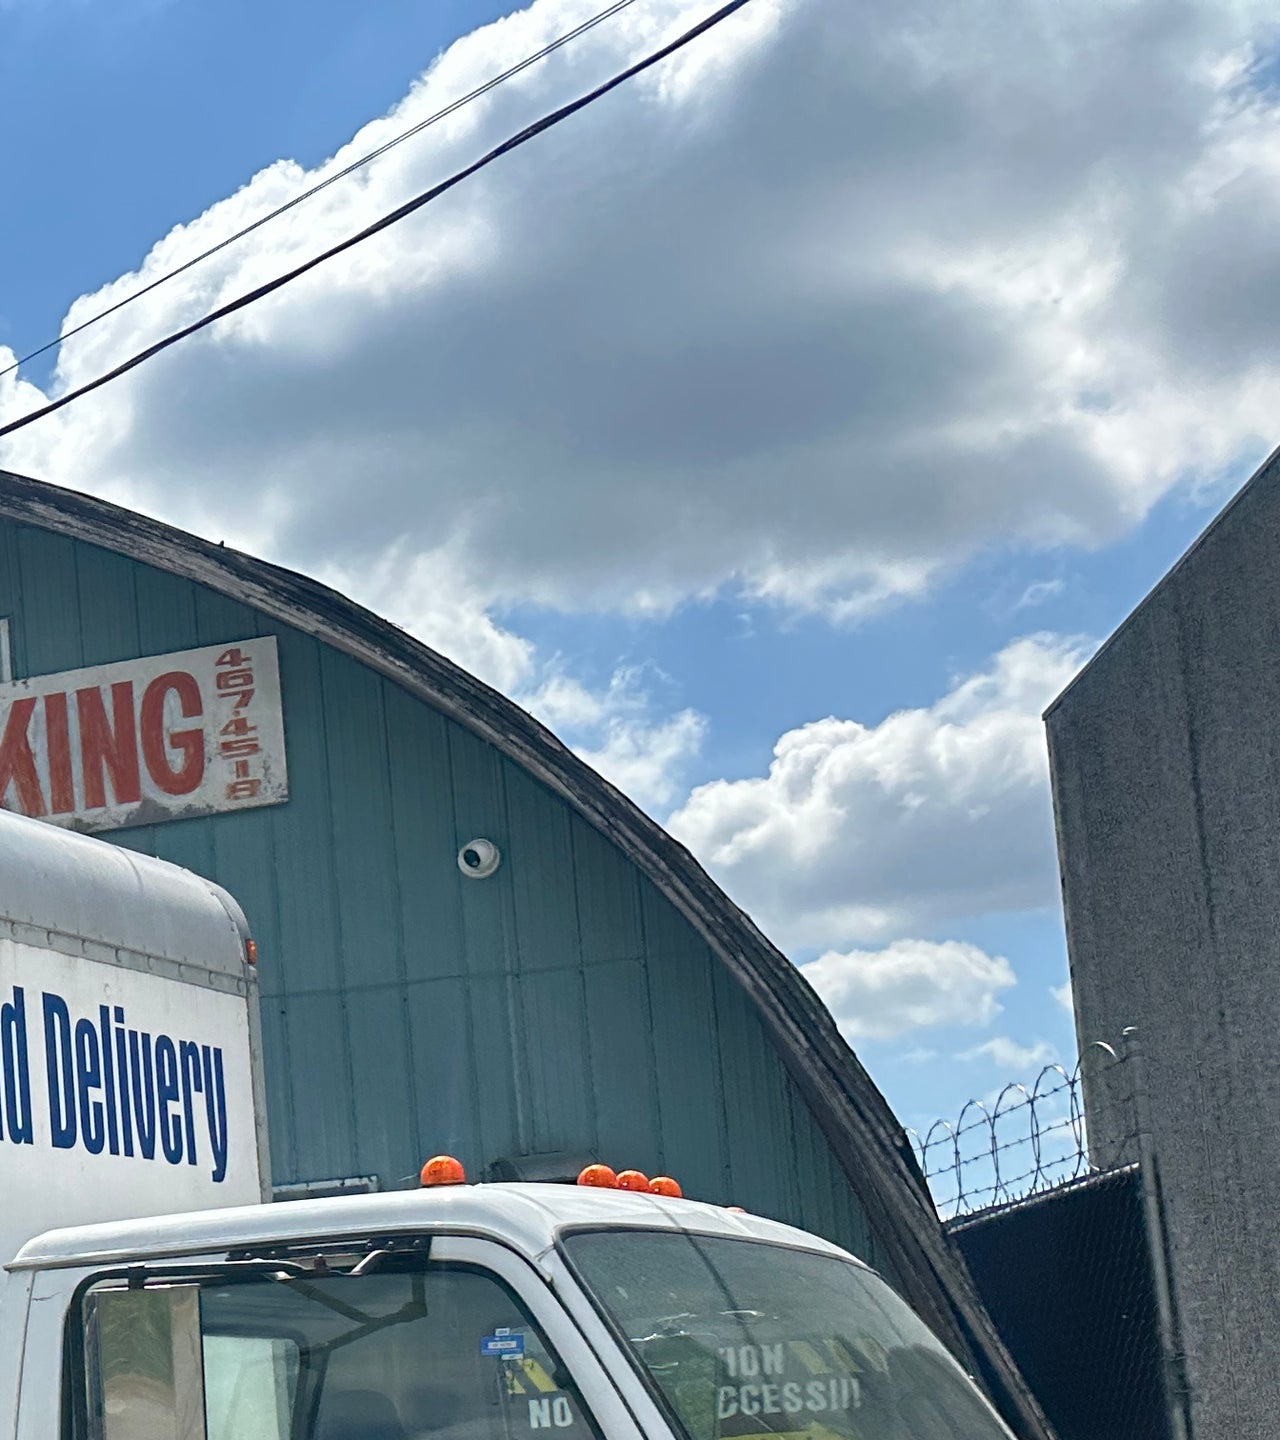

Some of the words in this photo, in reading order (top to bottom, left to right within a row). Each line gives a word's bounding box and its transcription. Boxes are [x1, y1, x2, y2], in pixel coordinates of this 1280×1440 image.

[42, 991, 228, 1183] Delivery
[719, 1343, 785, 1377] ION
[528, 1397, 574, 1429] NO
